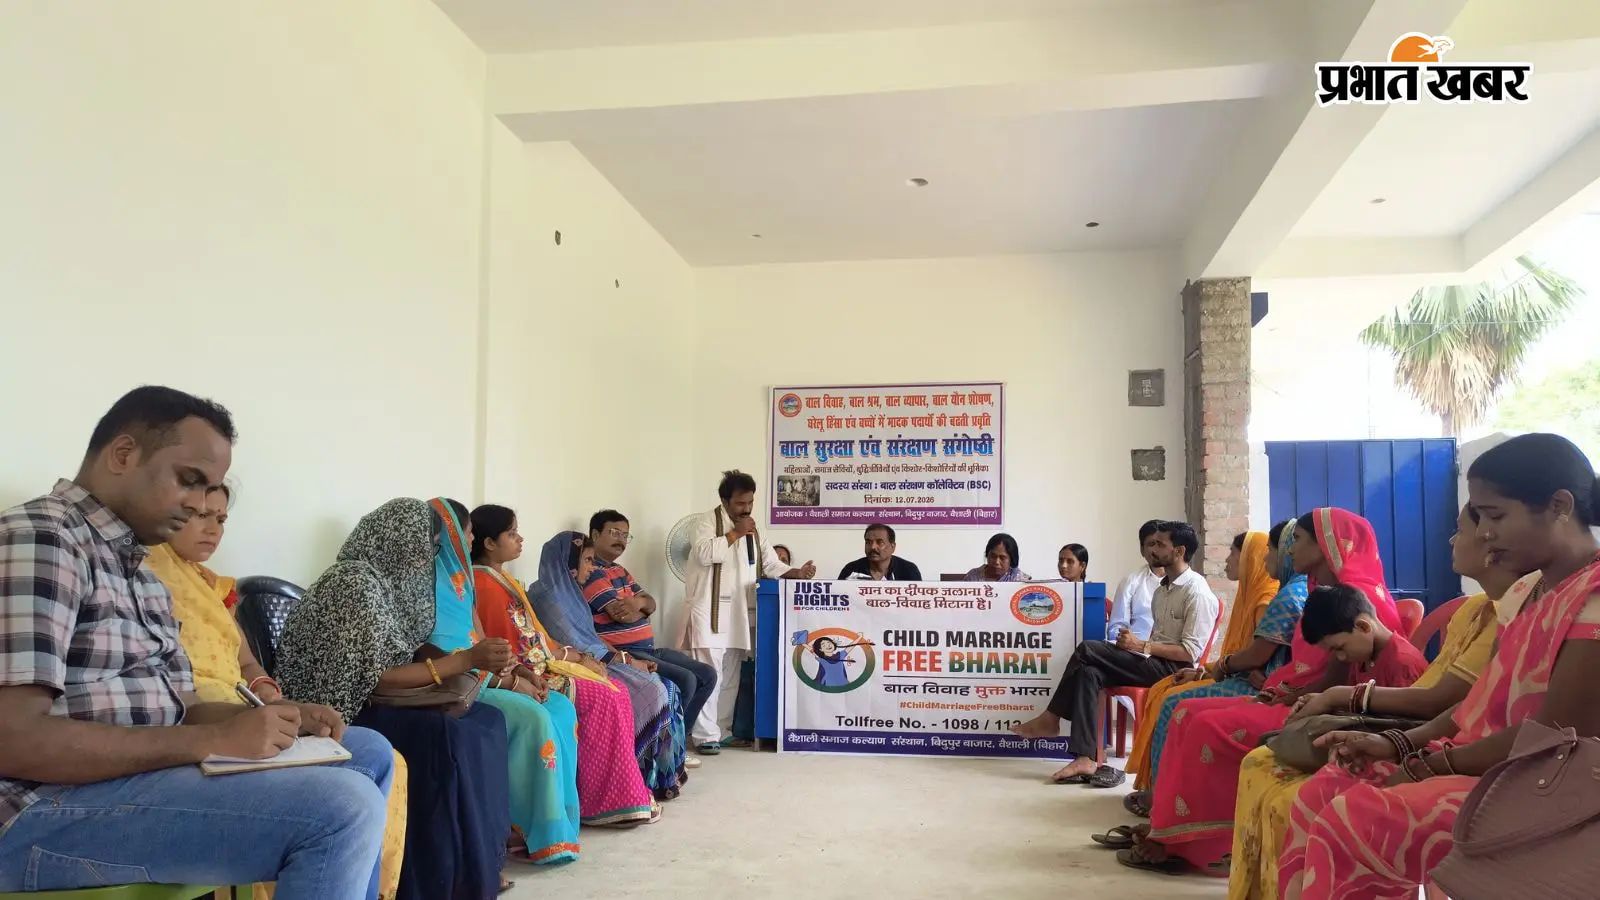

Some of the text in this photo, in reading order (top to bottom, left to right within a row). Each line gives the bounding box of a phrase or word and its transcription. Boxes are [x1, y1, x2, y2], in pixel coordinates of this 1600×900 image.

[805, 391, 994, 409] बाल विवाह, बाल श्रम, बाल व्यापार, बाल यौन शोषण,
[807, 415, 825, 432] घरेलू
[826, 414, 843, 428] हिंसा
[878, 414, 886, 428] में
[887, 416, 909, 428] मादक
[936, 412, 947, 427] की
[779, 440, 809, 458] बाल
[814, 439, 854, 463] सुरक्षा
[887, 433, 937, 458] संरक्षण
[942, 433, 995, 456] संगोष्ठी
[825, 481, 850, 490] सदस्य
[851, 480, 872, 490] संस्था
[880, 481, 896, 490] बाल
[898, 480, 925, 490] संरक्षण
[926, 478, 965, 490] कॉलेक्टिव
[966, 480, 991, 490] (BSC)
[864, 495, 893, 504] दिनांक:
[831, 510, 851, 518] समाज
[794, 582, 832, 594] JUST
[858, 583, 999, 598] ज्ञान का दीपक जलाना है,
[794, 594, 849, 606] RIGHTS
[866, 596, 931, 609] बाल-विवाह
[934, 596, 974, 609] मिटाना
[883, 629, 1052, 649] CHILD MARRIAGE
[883, 650, 1052, 674] FREE BHARAT
[883, 682, 1051, 698] बाल विवाह मुक्त भारत
[900, 701, 1034, 711] #ChildMarriageFreeBharat
[835, 715, 894, 728] Tollfree
[899, 716, 926, 729] No.
[942, 718, 980, 730] 1098
[788, 732, 818, 743] वैशाली
[821, 736, 849, 744] समाज
[851, 736, 886, 745] कल्याण
[931, 736, 961, 750] बिदुपुर
[998, 738, 1031, 749] वैशाली
[1033, 739, 1069, 752] (बिहार)
